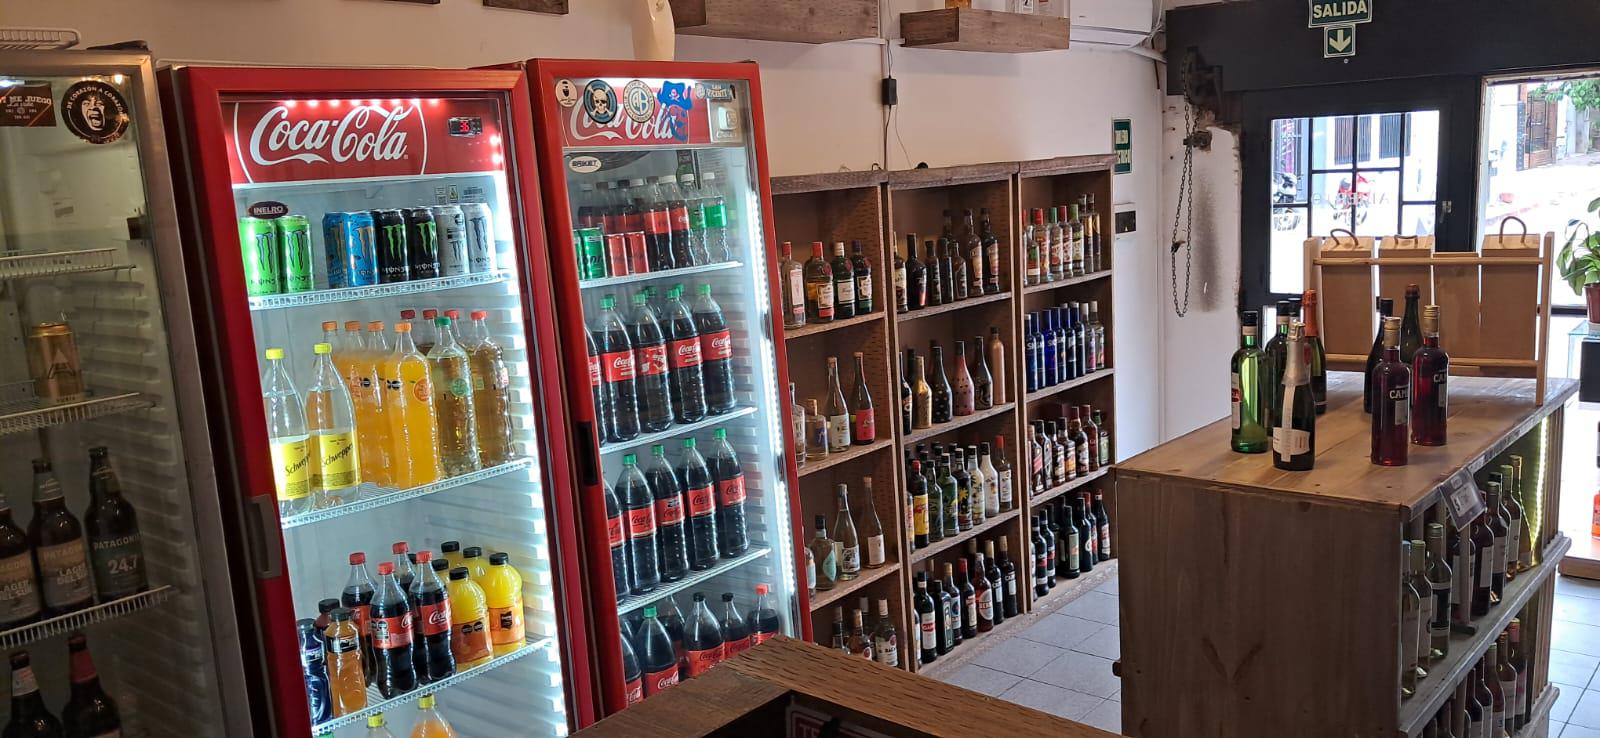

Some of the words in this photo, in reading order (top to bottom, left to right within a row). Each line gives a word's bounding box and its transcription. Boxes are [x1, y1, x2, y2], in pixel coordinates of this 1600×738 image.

[1313, 1, 1367, 18] SALIDA
[250, 101, 416, 166] Coca-Cola
[253, 205, 284, 216] INELRO
